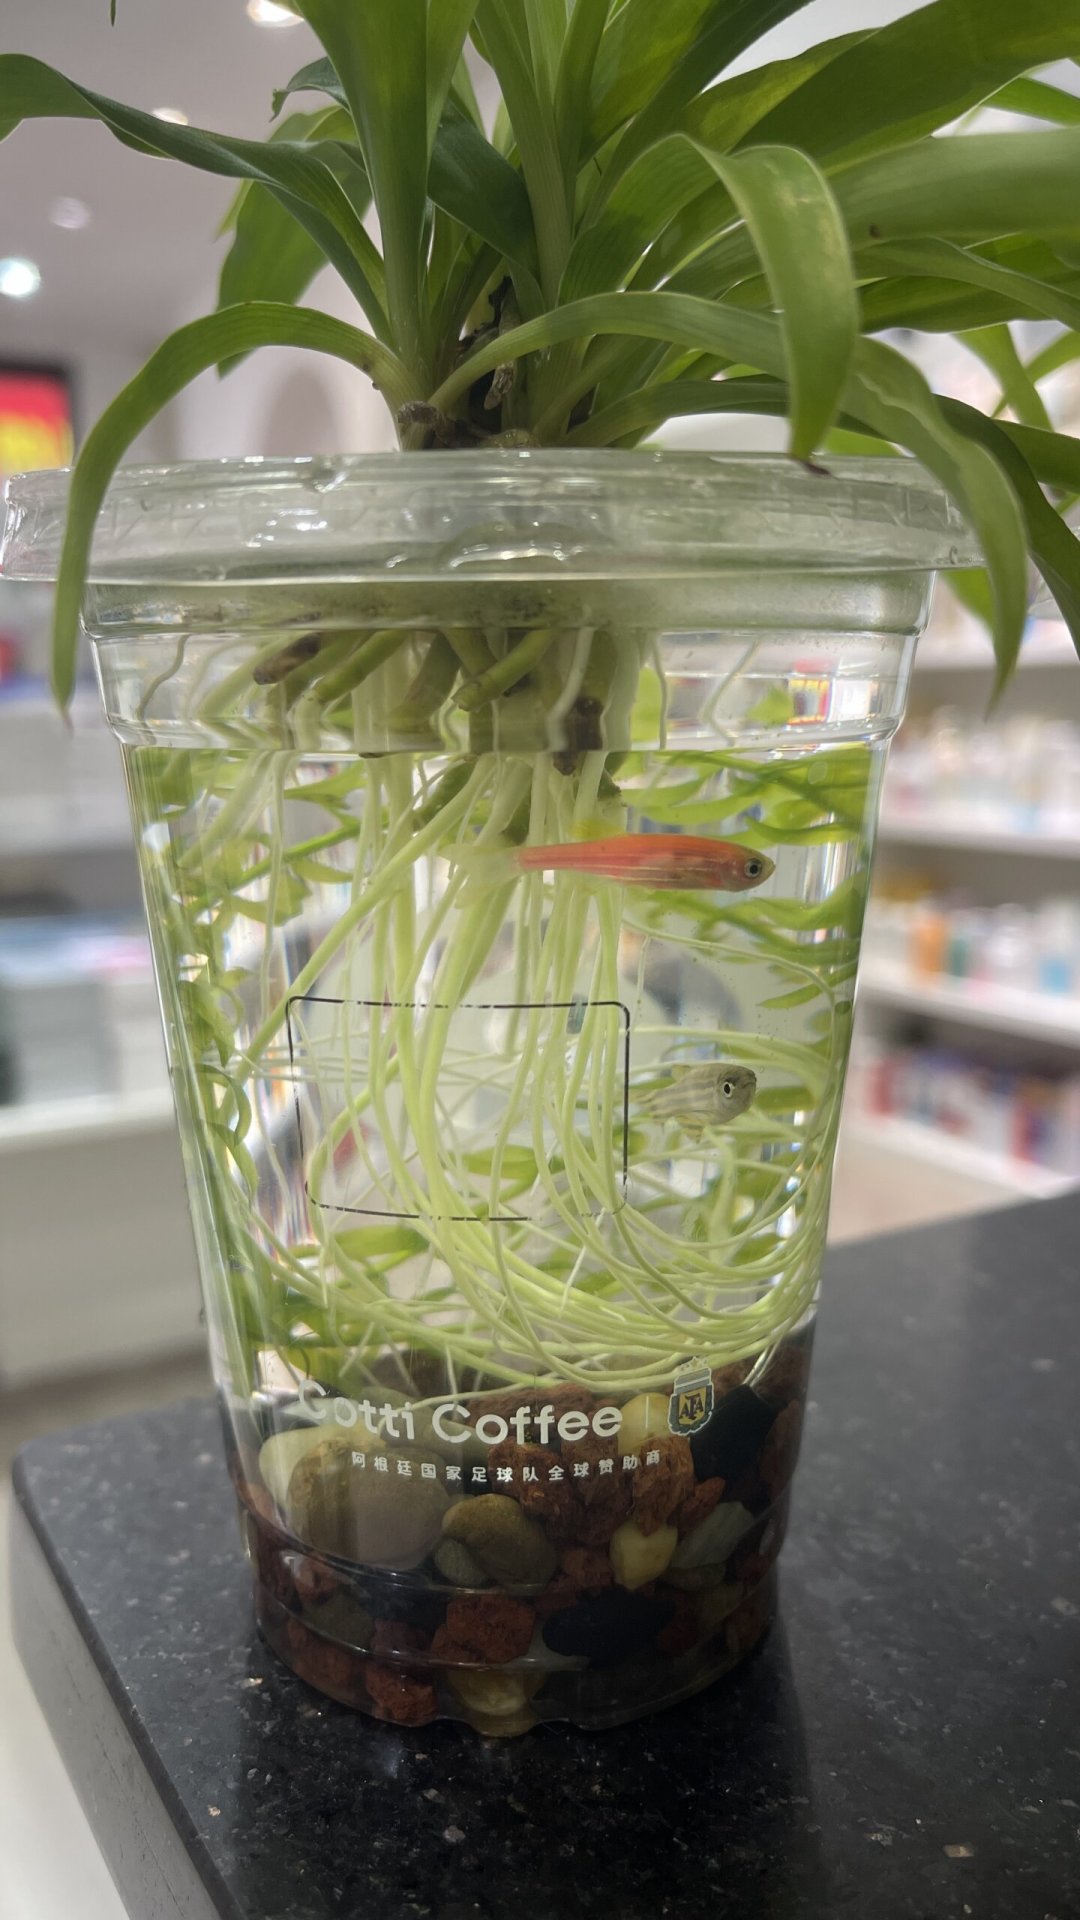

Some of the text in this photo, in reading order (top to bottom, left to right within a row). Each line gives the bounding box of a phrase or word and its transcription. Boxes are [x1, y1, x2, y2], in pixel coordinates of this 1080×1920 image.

[298, 1379, 623, 1445] Cotti Coffee
[351, 1450, 661, 1483] 阿根廷国家足球队全球赞助商
